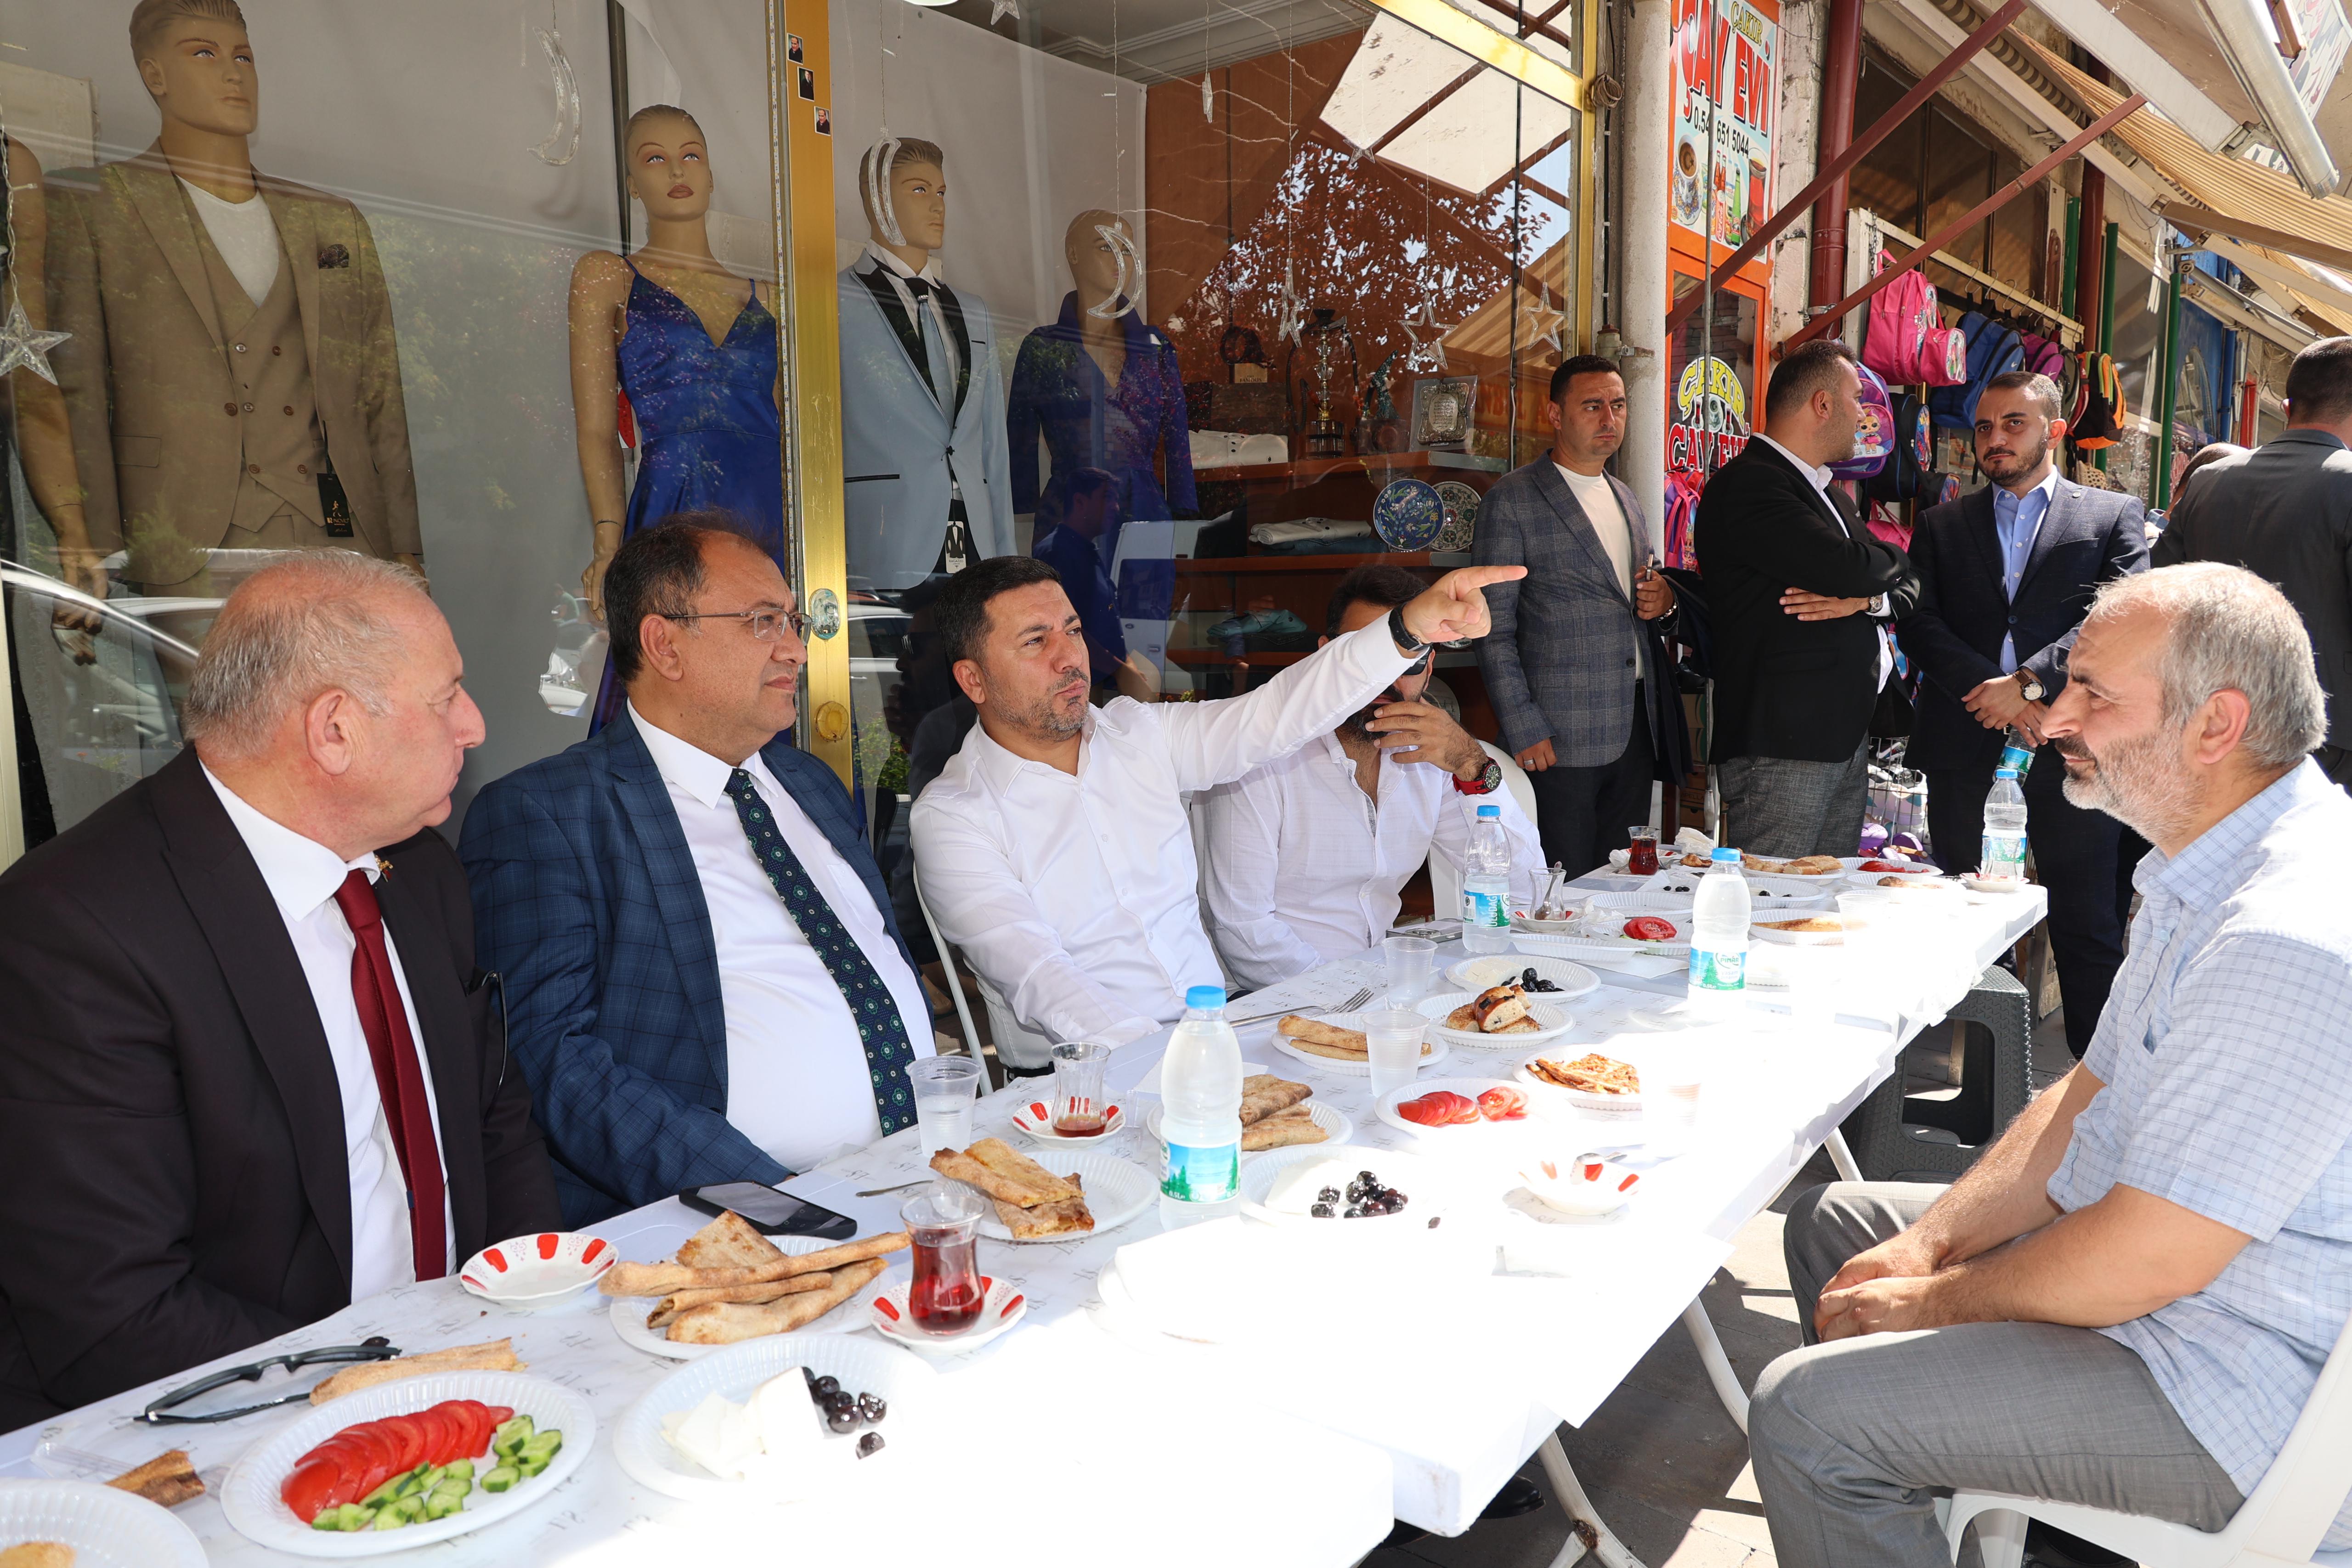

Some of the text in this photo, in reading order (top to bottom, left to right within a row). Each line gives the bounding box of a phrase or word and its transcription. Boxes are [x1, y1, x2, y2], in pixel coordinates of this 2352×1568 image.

[1731, 1, 1762, 46] ÇAKIR
[1681, 0, 1771, 137] ÇAY EVİ
[1717, 120, 1729, 147] 651
[1732, 129, 1748, 158] 5044
[1679, 359, 1745, 428] ÇAKIR
[1485, 896, 1498, 927] ULUDAĞ
